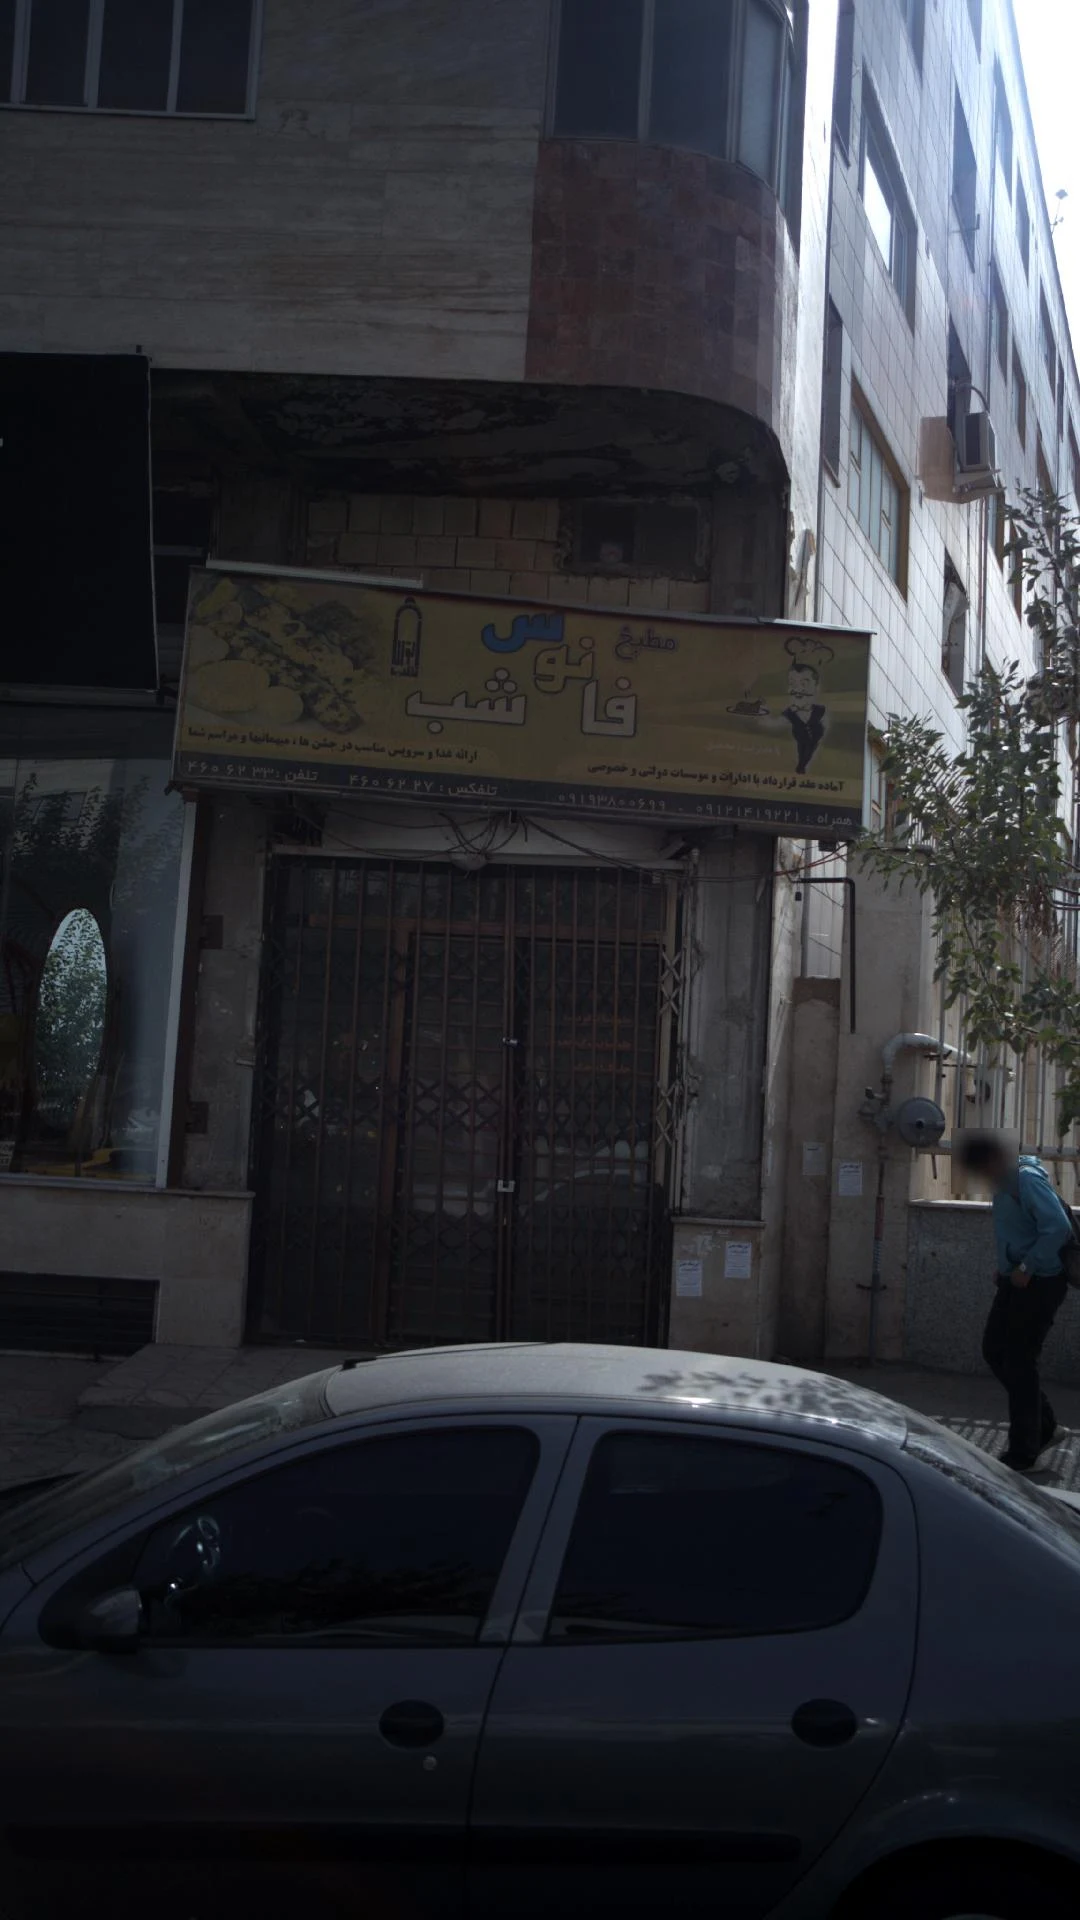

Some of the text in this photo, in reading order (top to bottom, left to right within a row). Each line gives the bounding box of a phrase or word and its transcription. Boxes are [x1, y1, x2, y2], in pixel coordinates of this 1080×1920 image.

[613, 624, 680, 662] مطبخ
[404, 666, 528, 735] شب
[187, 726, 206, 737] شما
[207, 729, 239, 743] مراسم
[817, 780, 845, 793] آماده
